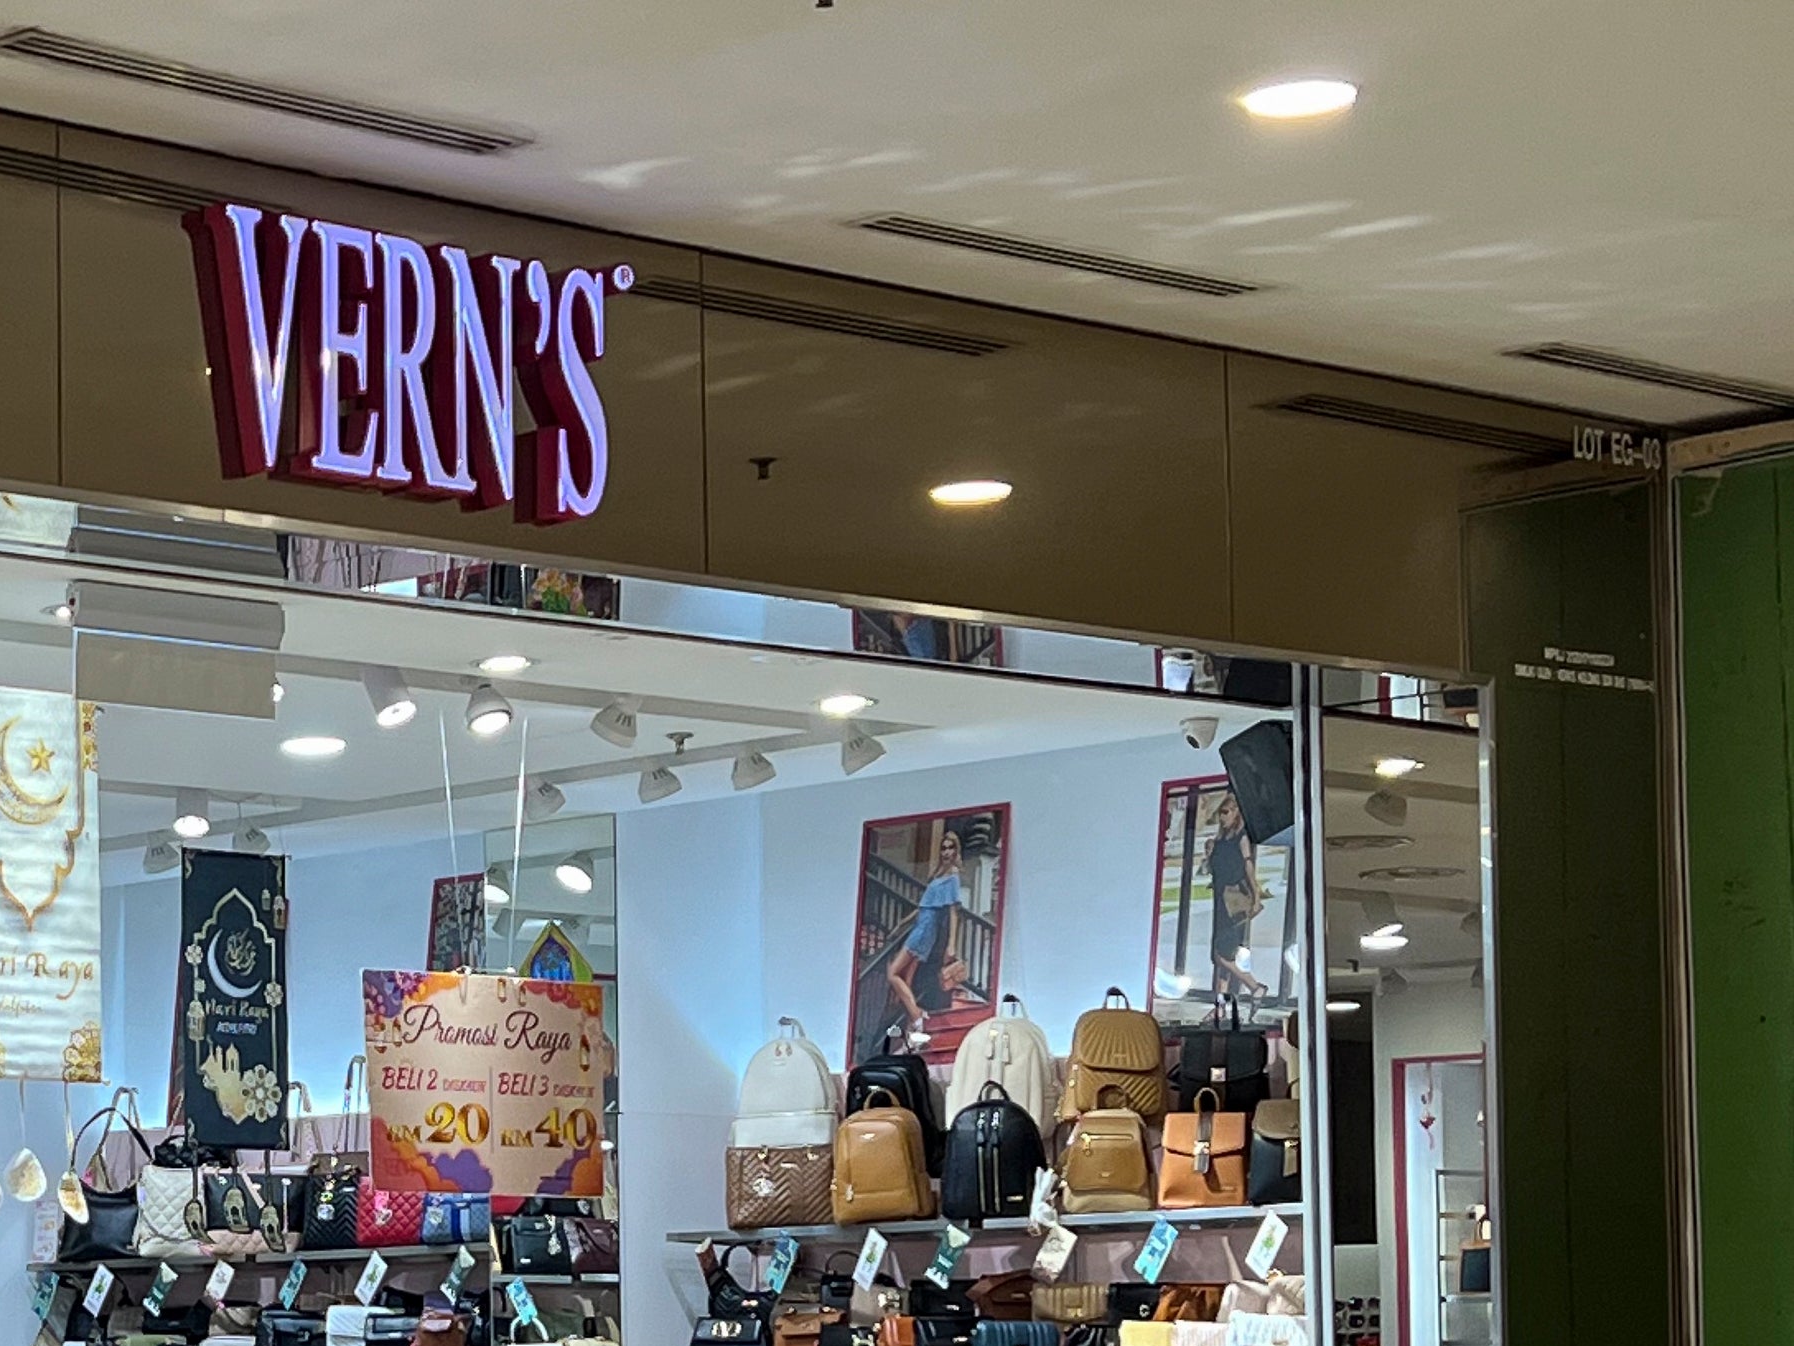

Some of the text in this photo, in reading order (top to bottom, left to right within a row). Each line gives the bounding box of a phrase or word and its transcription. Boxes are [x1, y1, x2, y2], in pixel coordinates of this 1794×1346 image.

[222, 202, 610, 519] VERN'S
[1573, 425, 1662, 470] LOT EG-03
[25, 951, 94, 1000] Raya
[401, 1003, 573, 1064] Promosi Raya
[381, 1065, 423, 1092] BELI
[427, 1068, 440, 1091] 2
[497, 1071, 535, 1097] BELI
[538, 1074, 550, 1097] 3
